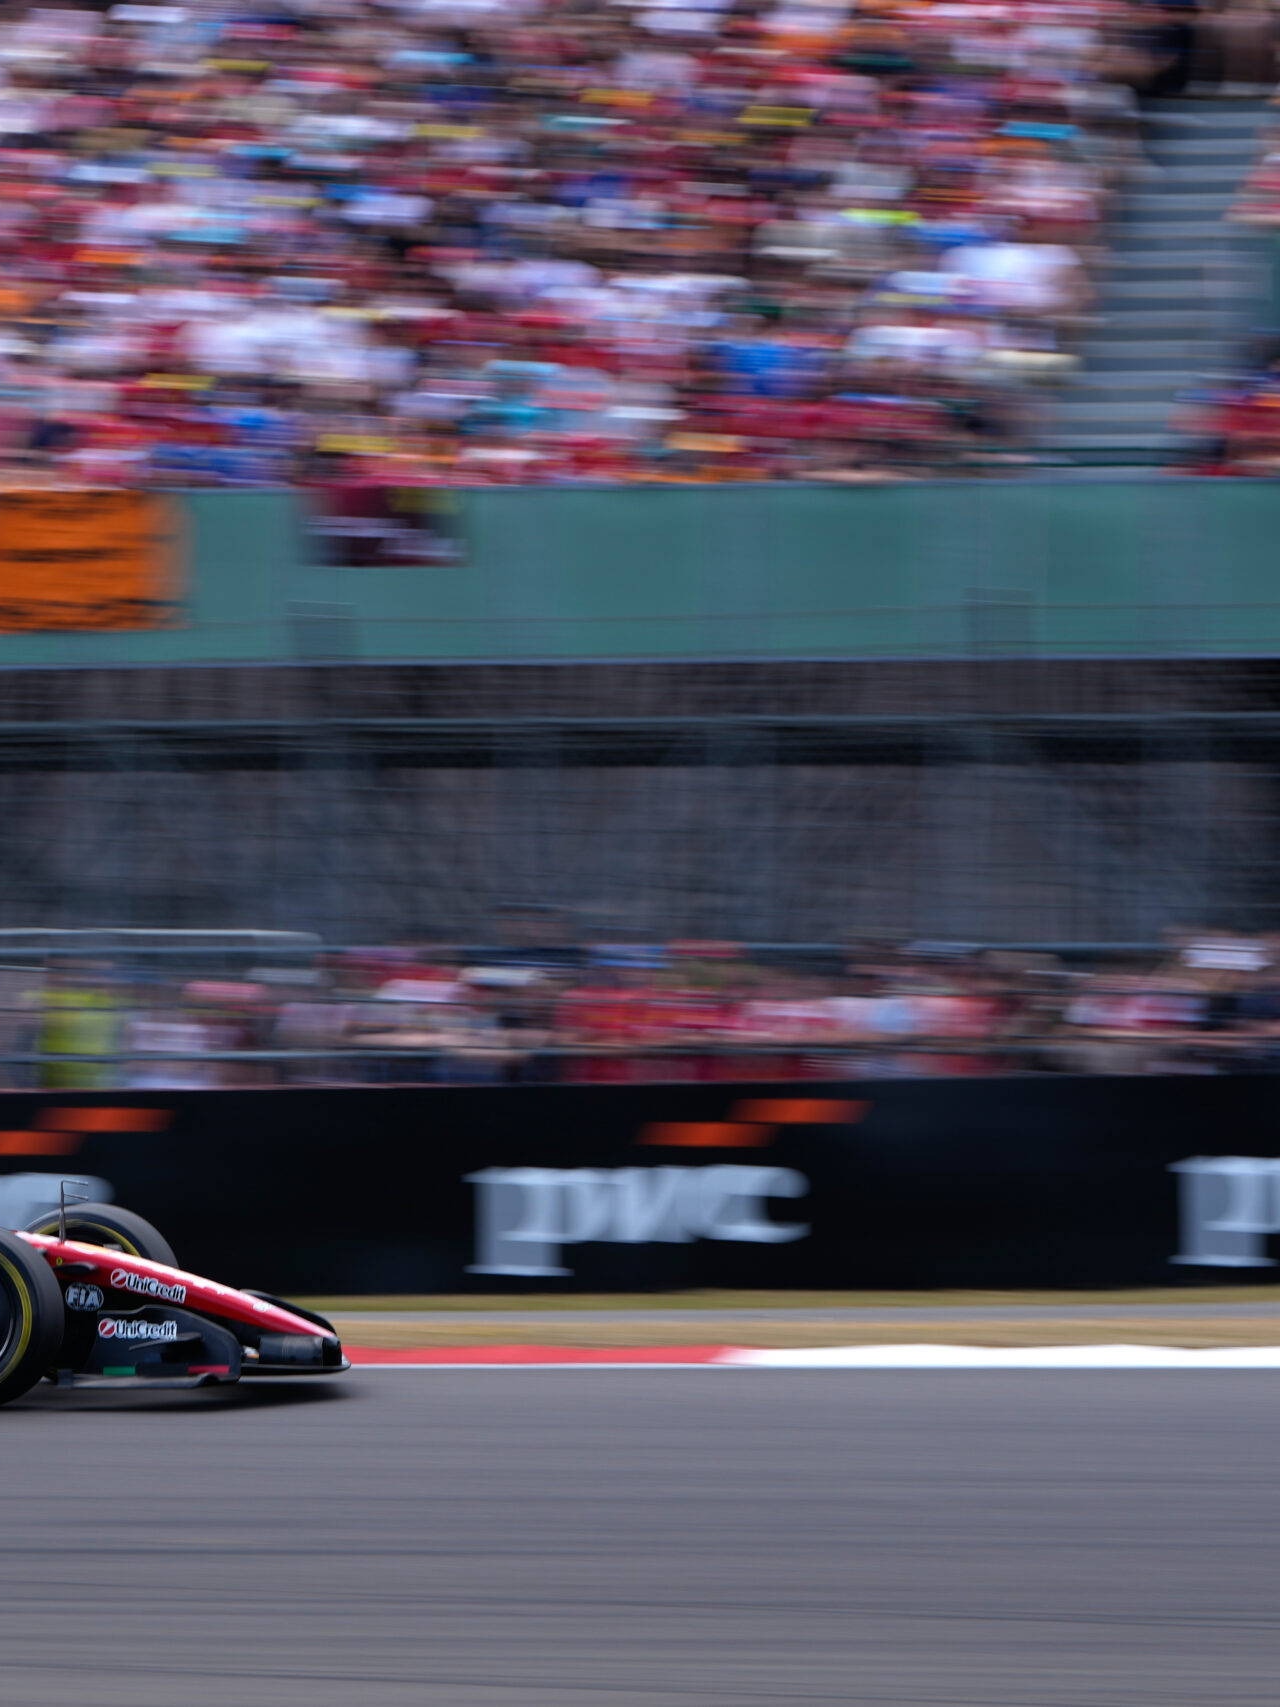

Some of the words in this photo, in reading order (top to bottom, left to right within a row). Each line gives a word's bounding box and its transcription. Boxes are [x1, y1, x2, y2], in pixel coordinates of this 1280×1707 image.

[66, 1286, 101, 1308] FIA
[126, 1273, 186, 1303] UniCredit
[114, 1320, 177, 1340] UniCredit
